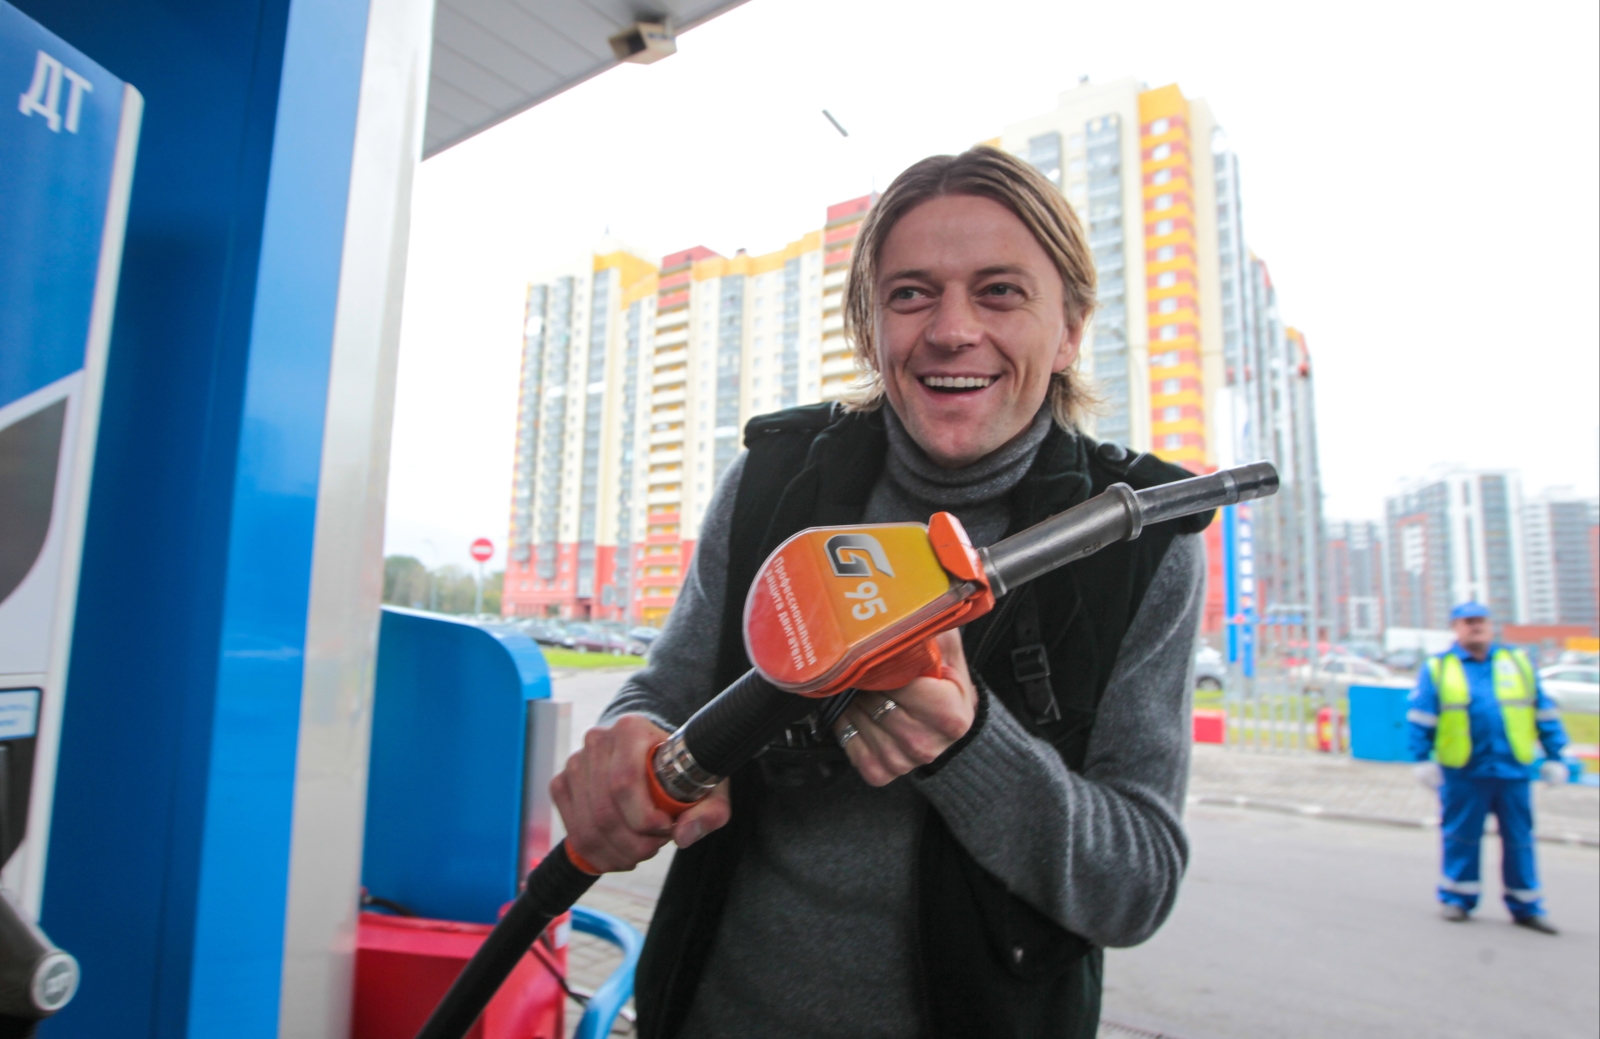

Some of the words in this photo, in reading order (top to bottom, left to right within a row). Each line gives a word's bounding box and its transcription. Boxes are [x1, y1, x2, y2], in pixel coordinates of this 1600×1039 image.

[18, 50, 93, 135] ДТ
[824, 533, 896, 578] G
[764, 568, 785, 611] защита
[777, 610, 805, 671] двигателя
[773, 555, 817, 666] Профессиональная
[844, 581, 889, 621] 95
